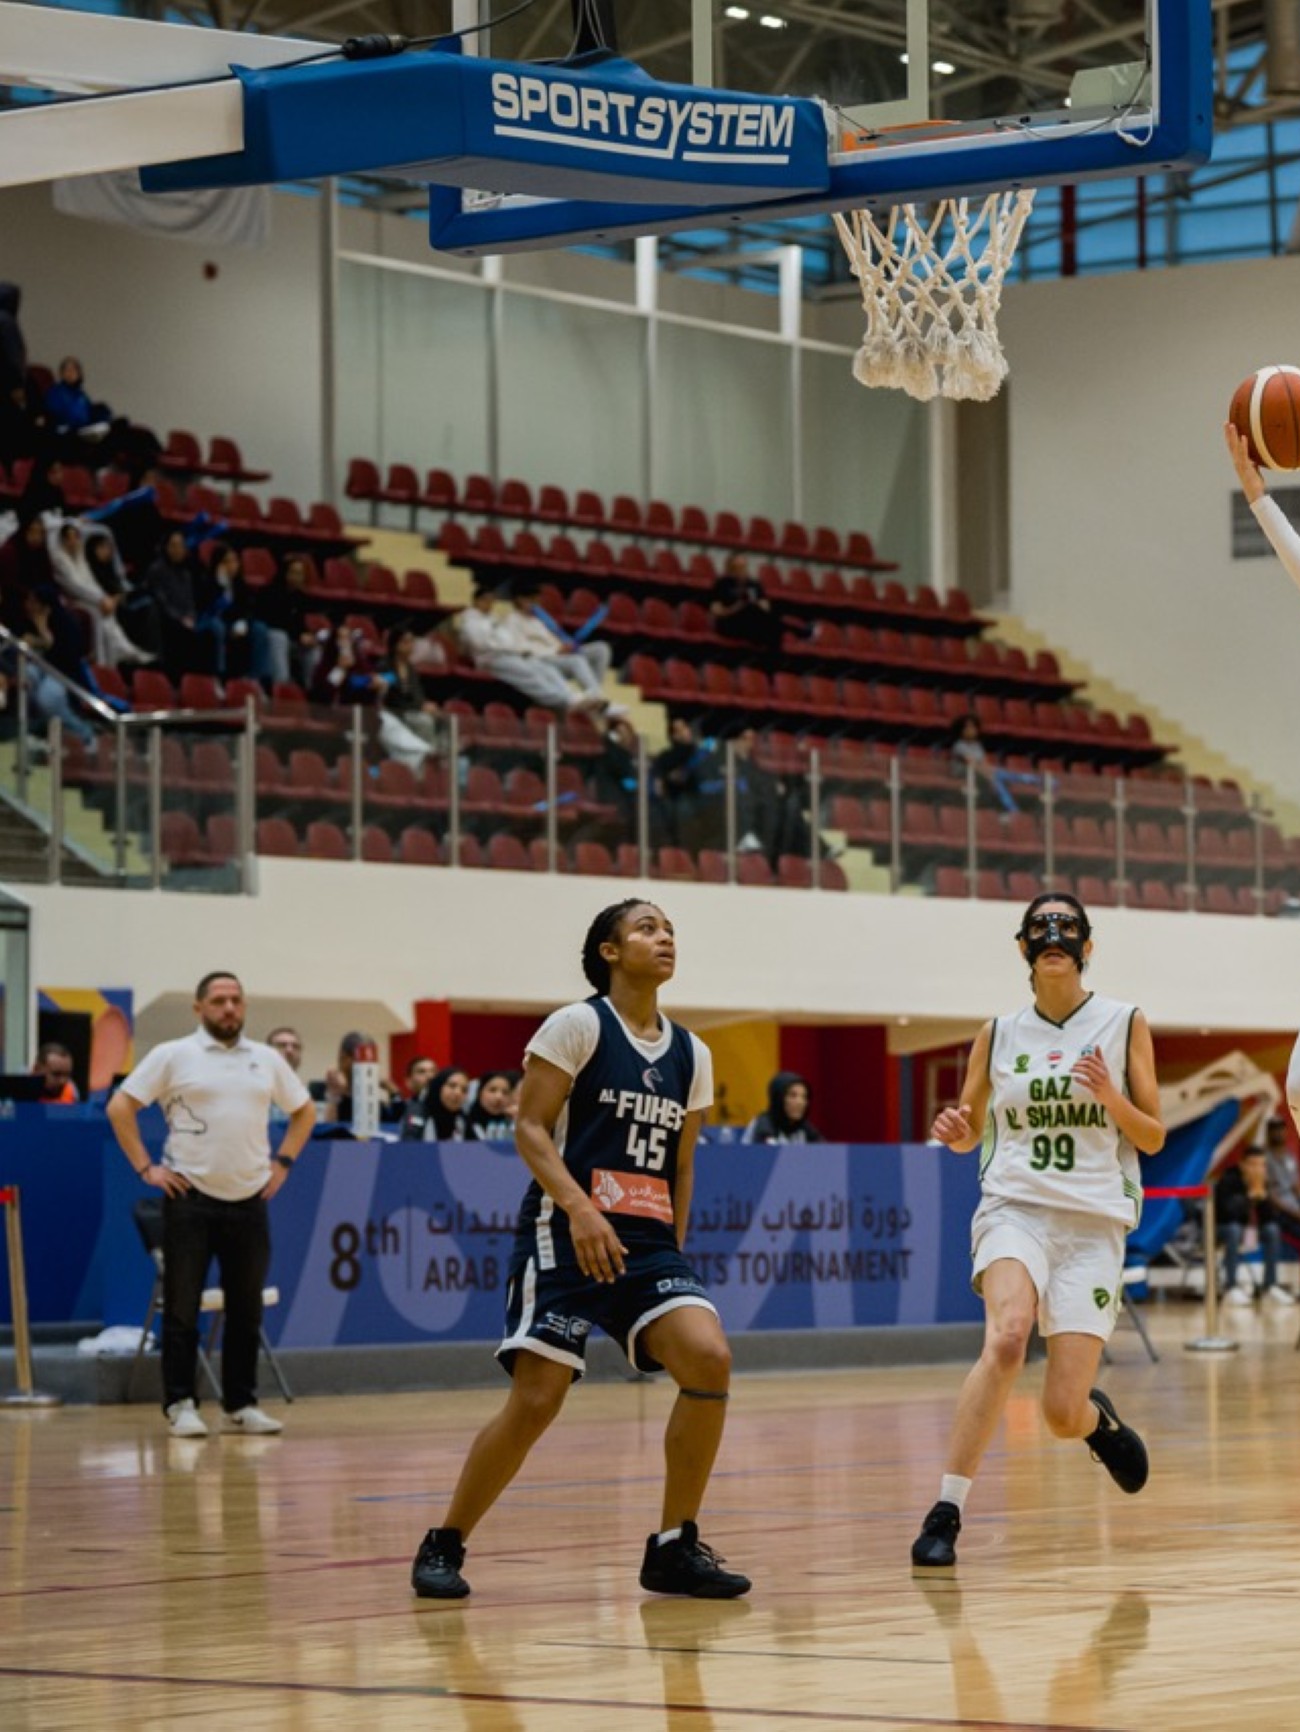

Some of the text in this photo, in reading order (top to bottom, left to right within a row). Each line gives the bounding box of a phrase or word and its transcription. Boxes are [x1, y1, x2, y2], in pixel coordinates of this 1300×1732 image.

[491, 72, 797, 160] SPORTSYSTEM
[599, 1088, 617, 1104] AL
[1029, 1075, 1072, 1102] GAZ
[1026, 1102, 1108, 1129] SHAMAL
[625, 1123, 668, 1171] 45
[1029, 1133, 1075, 1172] 99
[761, 1193, 854, 1242] الألعاب
[862, 1194, 912, 1240] دورة
[329, 1216, 400, 1292] 8th
[422, 1254, 499, 1292] ARAB
[737, 1248, 913, 1286] TOURNAMENT
